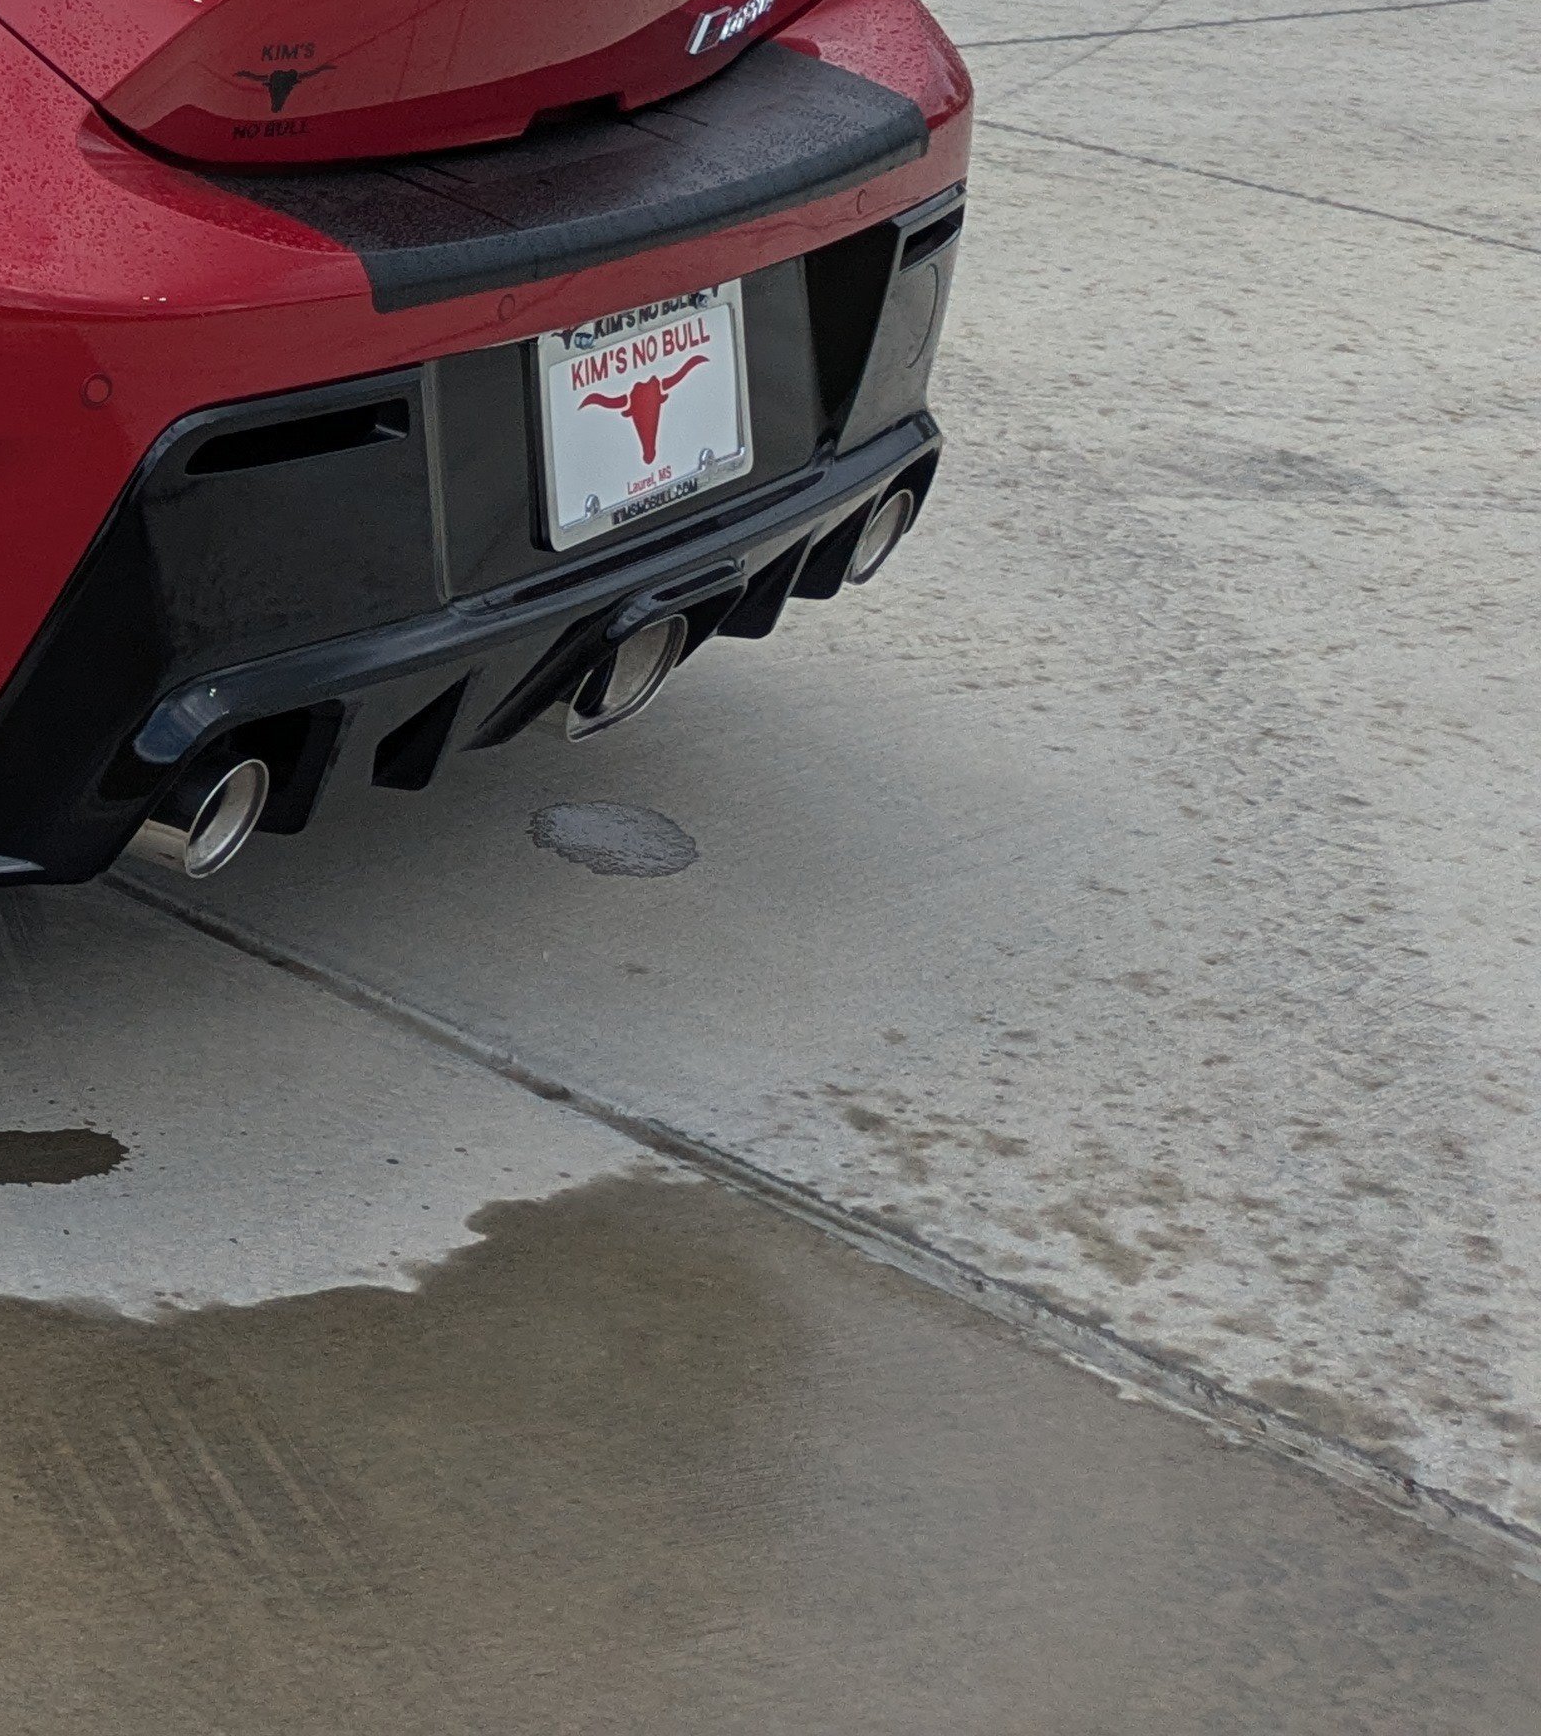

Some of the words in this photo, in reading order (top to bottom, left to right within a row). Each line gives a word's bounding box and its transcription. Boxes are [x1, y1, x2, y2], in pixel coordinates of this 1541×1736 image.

[261, 42, 315, 62] KIM'S
[571, 346, 627, 391] KIM'S
[632, 335, 658, 369] NO
[662, 318, 710, 357] BULL
